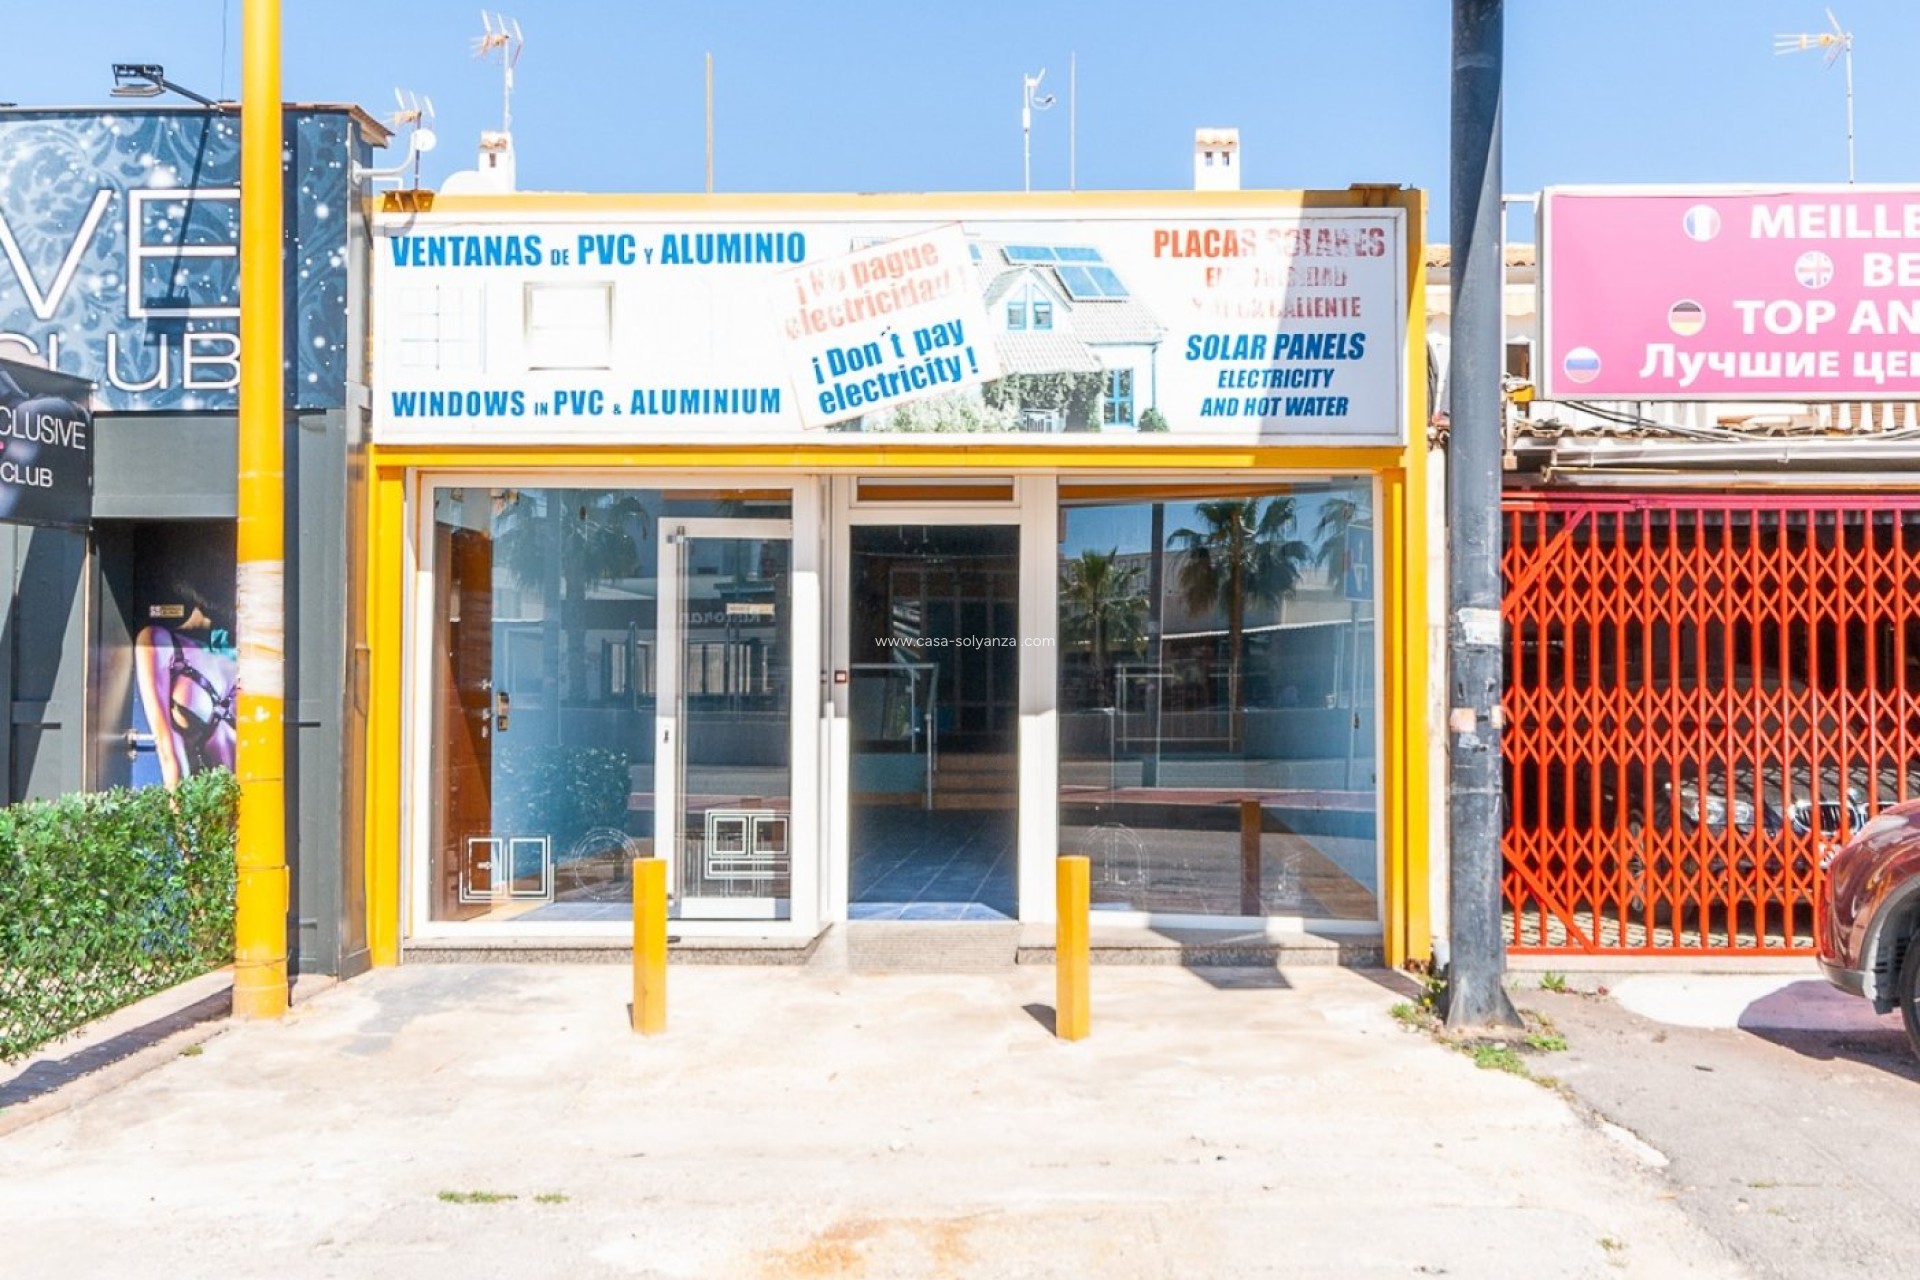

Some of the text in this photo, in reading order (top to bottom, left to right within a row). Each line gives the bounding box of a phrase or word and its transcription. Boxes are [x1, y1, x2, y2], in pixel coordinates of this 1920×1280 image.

[391, 231, 806, 267] VENTANAS DE PVC Y ALUMINIO
[1733, 300, 1836, 335] TOP
[912, 318, 965, 355] pay
[1185, 332, 1366, 361] SOLAR PANELS
[1217, 368, 1335, 389] ELECTRICITY
[391, 387, 781, 417] WINDOWS IN PVC & ALUMINIUM
[1200, 396, 1349, 417] AND HOT WATER
[0, 461, 53, 488] CLUB
